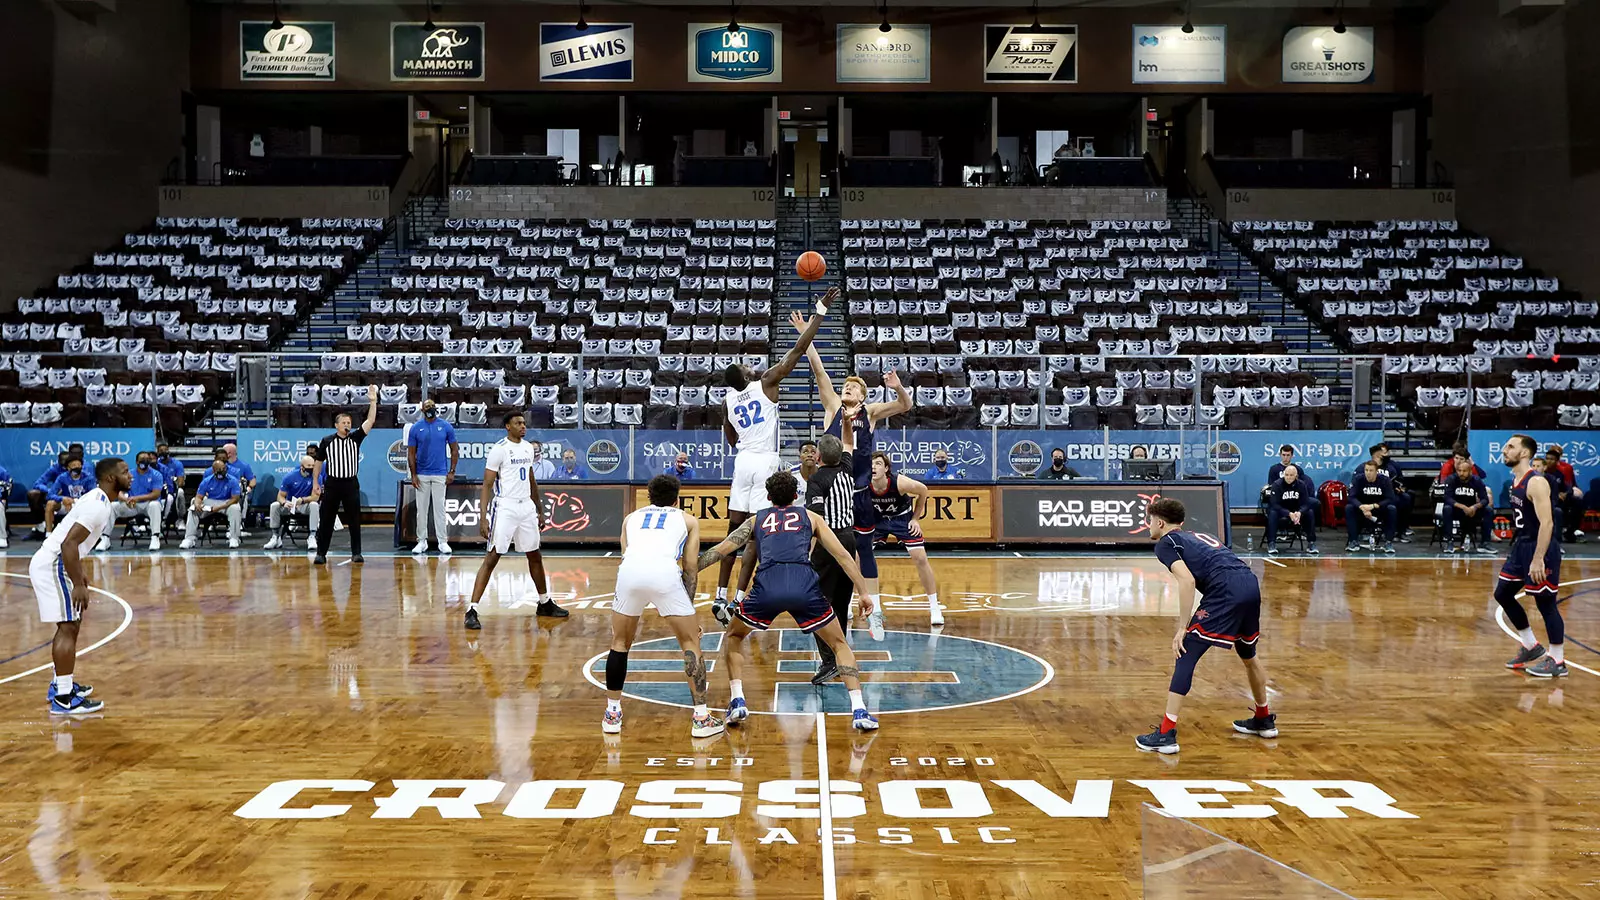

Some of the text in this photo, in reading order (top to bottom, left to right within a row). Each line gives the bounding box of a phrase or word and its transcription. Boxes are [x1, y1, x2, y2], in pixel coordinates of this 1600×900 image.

[567, 38, 626, 64] LEWIS
[711, 50, 760, 63] MIDCO
[403, 60, 473, 70] MAMMOTH
[1005, 55, 1054, 65] Neon
[1290, 62, 1366, 71] GREATSHOTS
[163, 189, 182, 201] 101
[367, 189, 386, 200] 101
[451, 189, 472, 201] 102
[753, 190, 774, 201] 102
[843, 190, 865, 201] 103
[1432, 191, 1453, 203] 104
[733, 400, 765, 428] 32
[254, 440, 290, 450] BAD
[876, 442, 954, 452] BAD BOY
[520, 467, 526, 481] 0
[1362, 487, 1382, 496] GAELS
[1455, 487, 1475, 496] GAELS
[1038, 500, 1136, 513] BAD BOY
[640, 513, 667, 530] 11
[761, 511, 801, 534] 42
[1039, 514, 1134, 527] MOWERS
[1194, 532, 1221, 548] 0
[645, 757, 996, 767] ESTD 2020
[233, 779, 1419, 819] CROSSOVER
[643, 827, 1017, 844] CLASSIC
